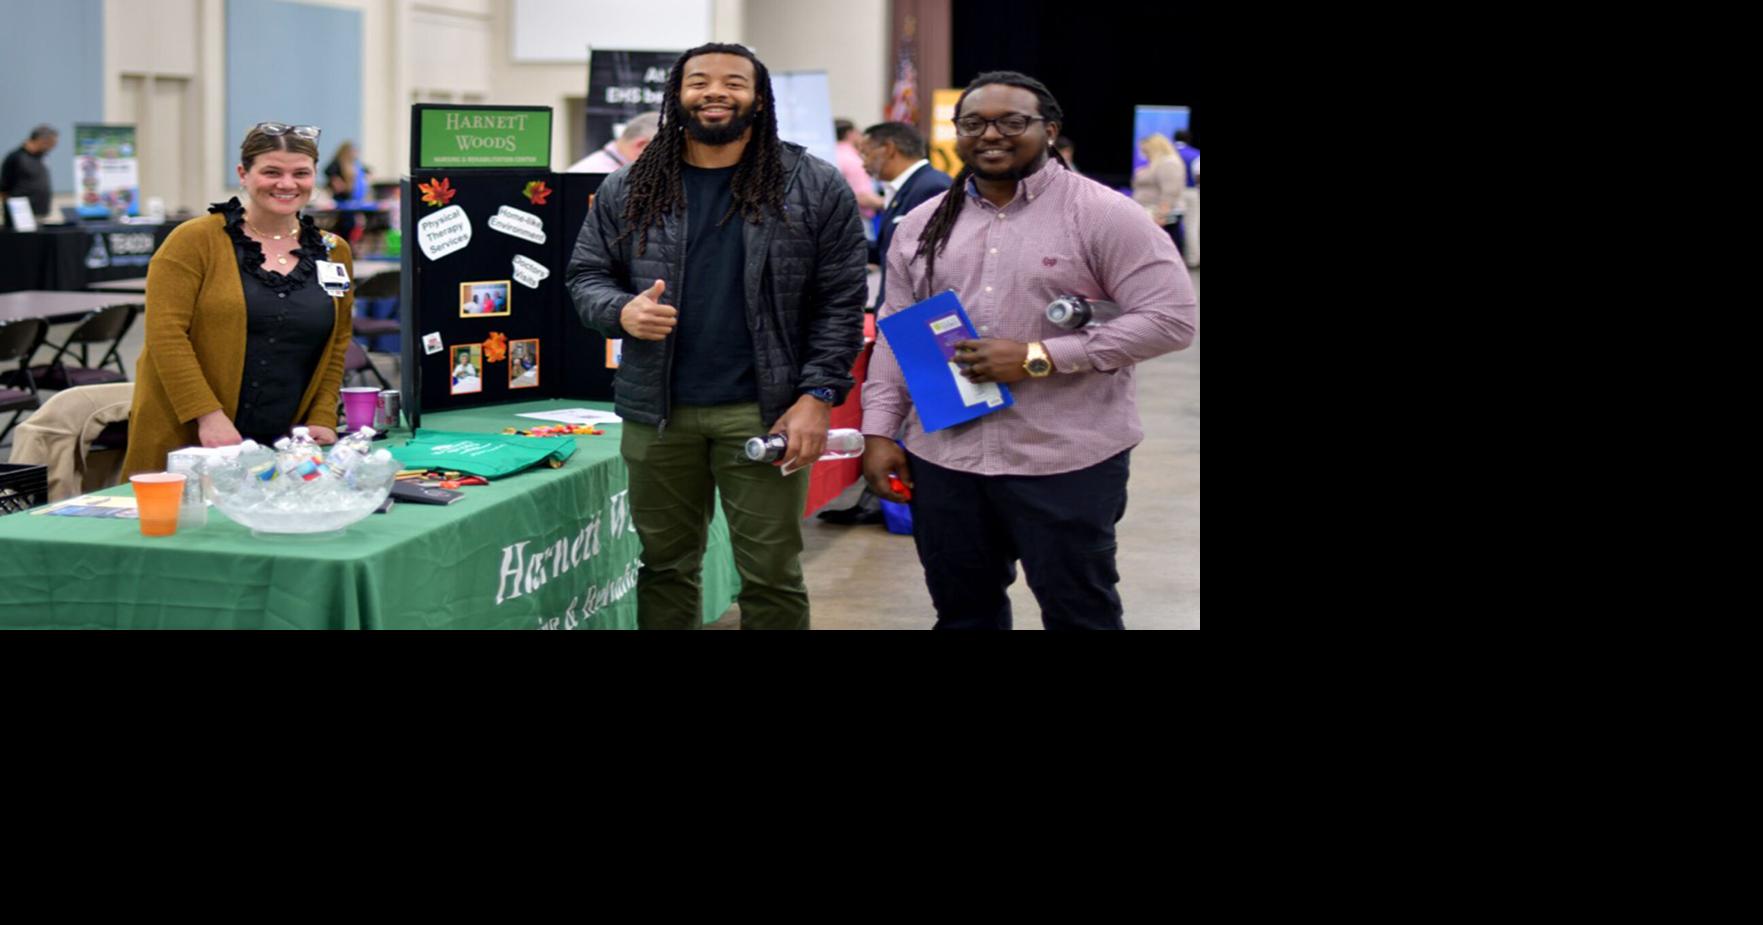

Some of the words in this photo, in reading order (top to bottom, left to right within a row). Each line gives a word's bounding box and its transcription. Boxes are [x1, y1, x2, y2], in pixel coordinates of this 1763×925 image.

[446, 112, 529, 131] HARNETT
[455, 135, 517, 152] WOODS
[421, 209, 461, 231] Physical
[491, 217, 545, 242] Environment
[427, 222, 463, 242] Therapy
[430, 233, 468, 254] Services
[515, 270, 538, 286] Visits
